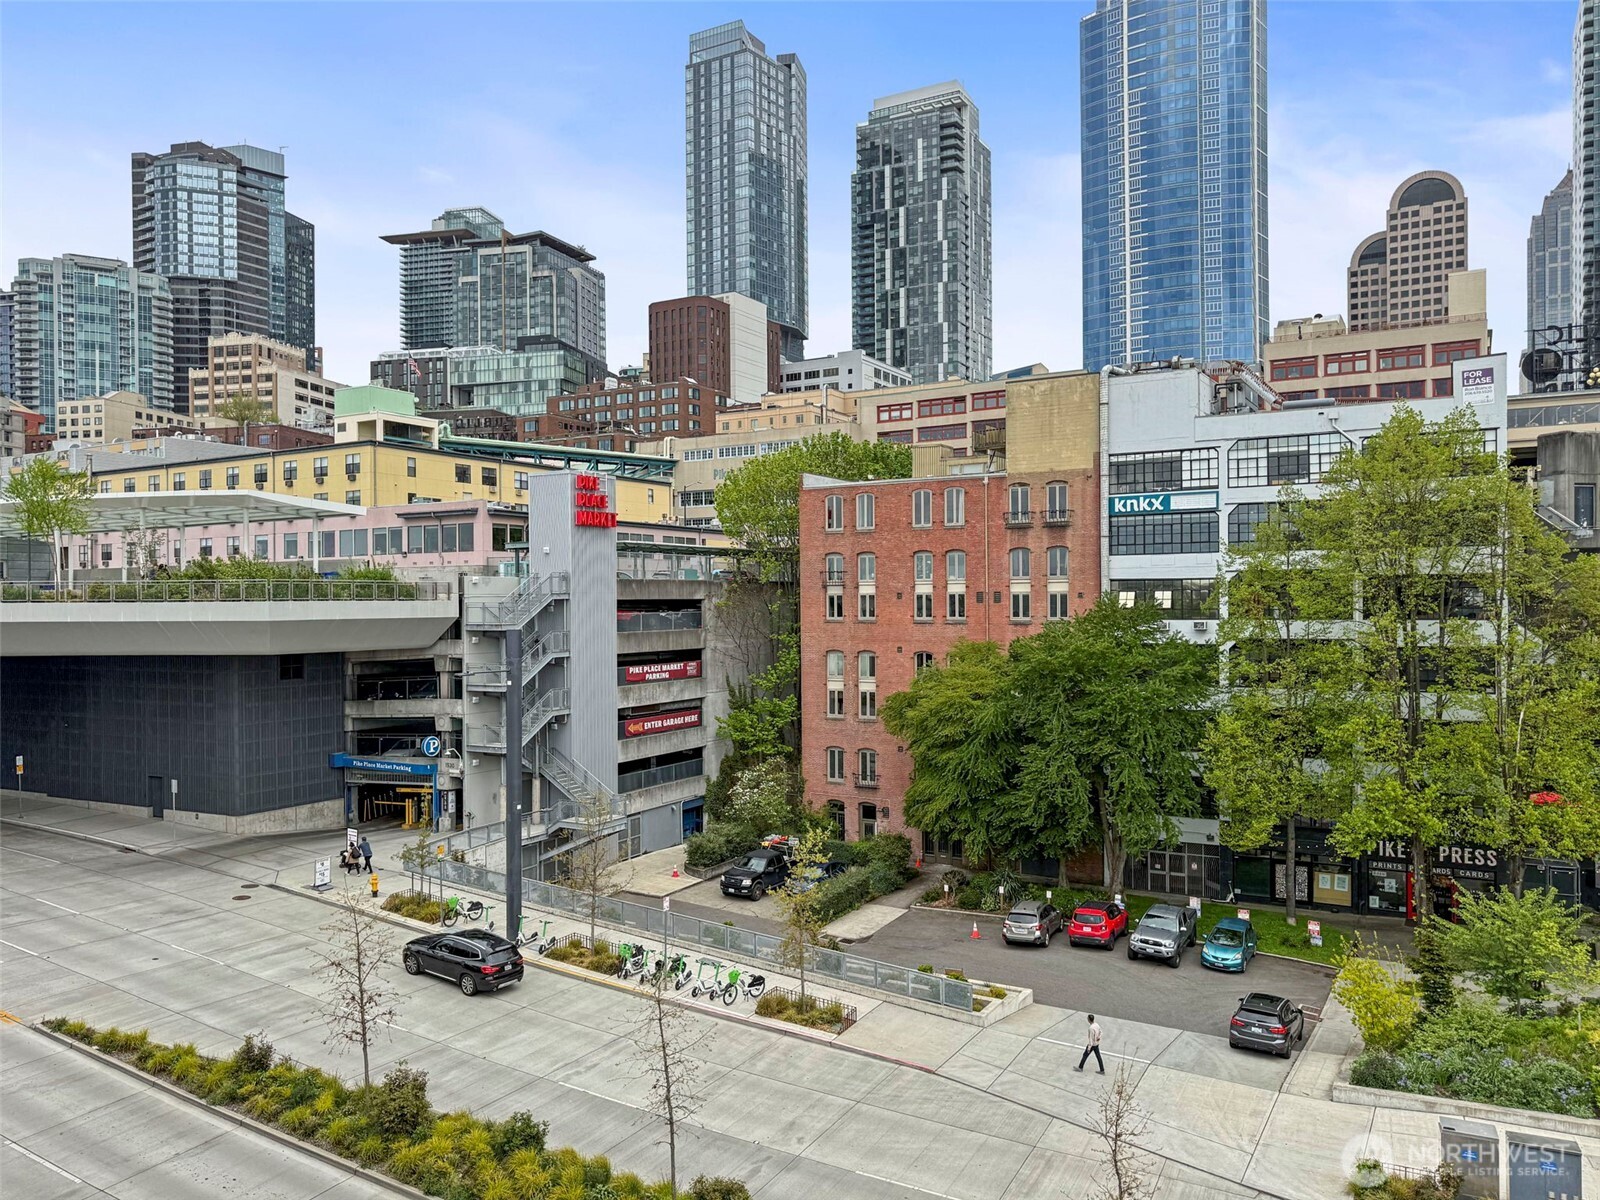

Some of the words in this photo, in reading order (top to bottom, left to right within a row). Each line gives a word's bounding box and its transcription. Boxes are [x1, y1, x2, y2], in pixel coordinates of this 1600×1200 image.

[1463, 370, 1483, 379] FOR
[1464, 376, 1493, 386] LEASE
[575, 474, 600, 491] PIKE
[575, 491, 608, 509] PLACE
[1114, 495, 1164, 513] knkx
[575, 510, 619, 528] MARKET
[629, 666, 643, 674] PIKE
[643, 664, 661, 673] PLACE
[661, 663, 684, 671] MARKET
[645, 672, 670, 680] PARKING
[644, 721, 662, 730] ENTER
[662, 717, 684, 727] GARAGE
[684, 714, 698, 723] HERE
[429, 740, 438, 753] P
[392, 764, 412, 772] Parking
[1439, 845, 1498, 867] PRESS
[1372, 861, 1403, 870] PRINTS
[1459, 870, 1490, 879] CARDS
